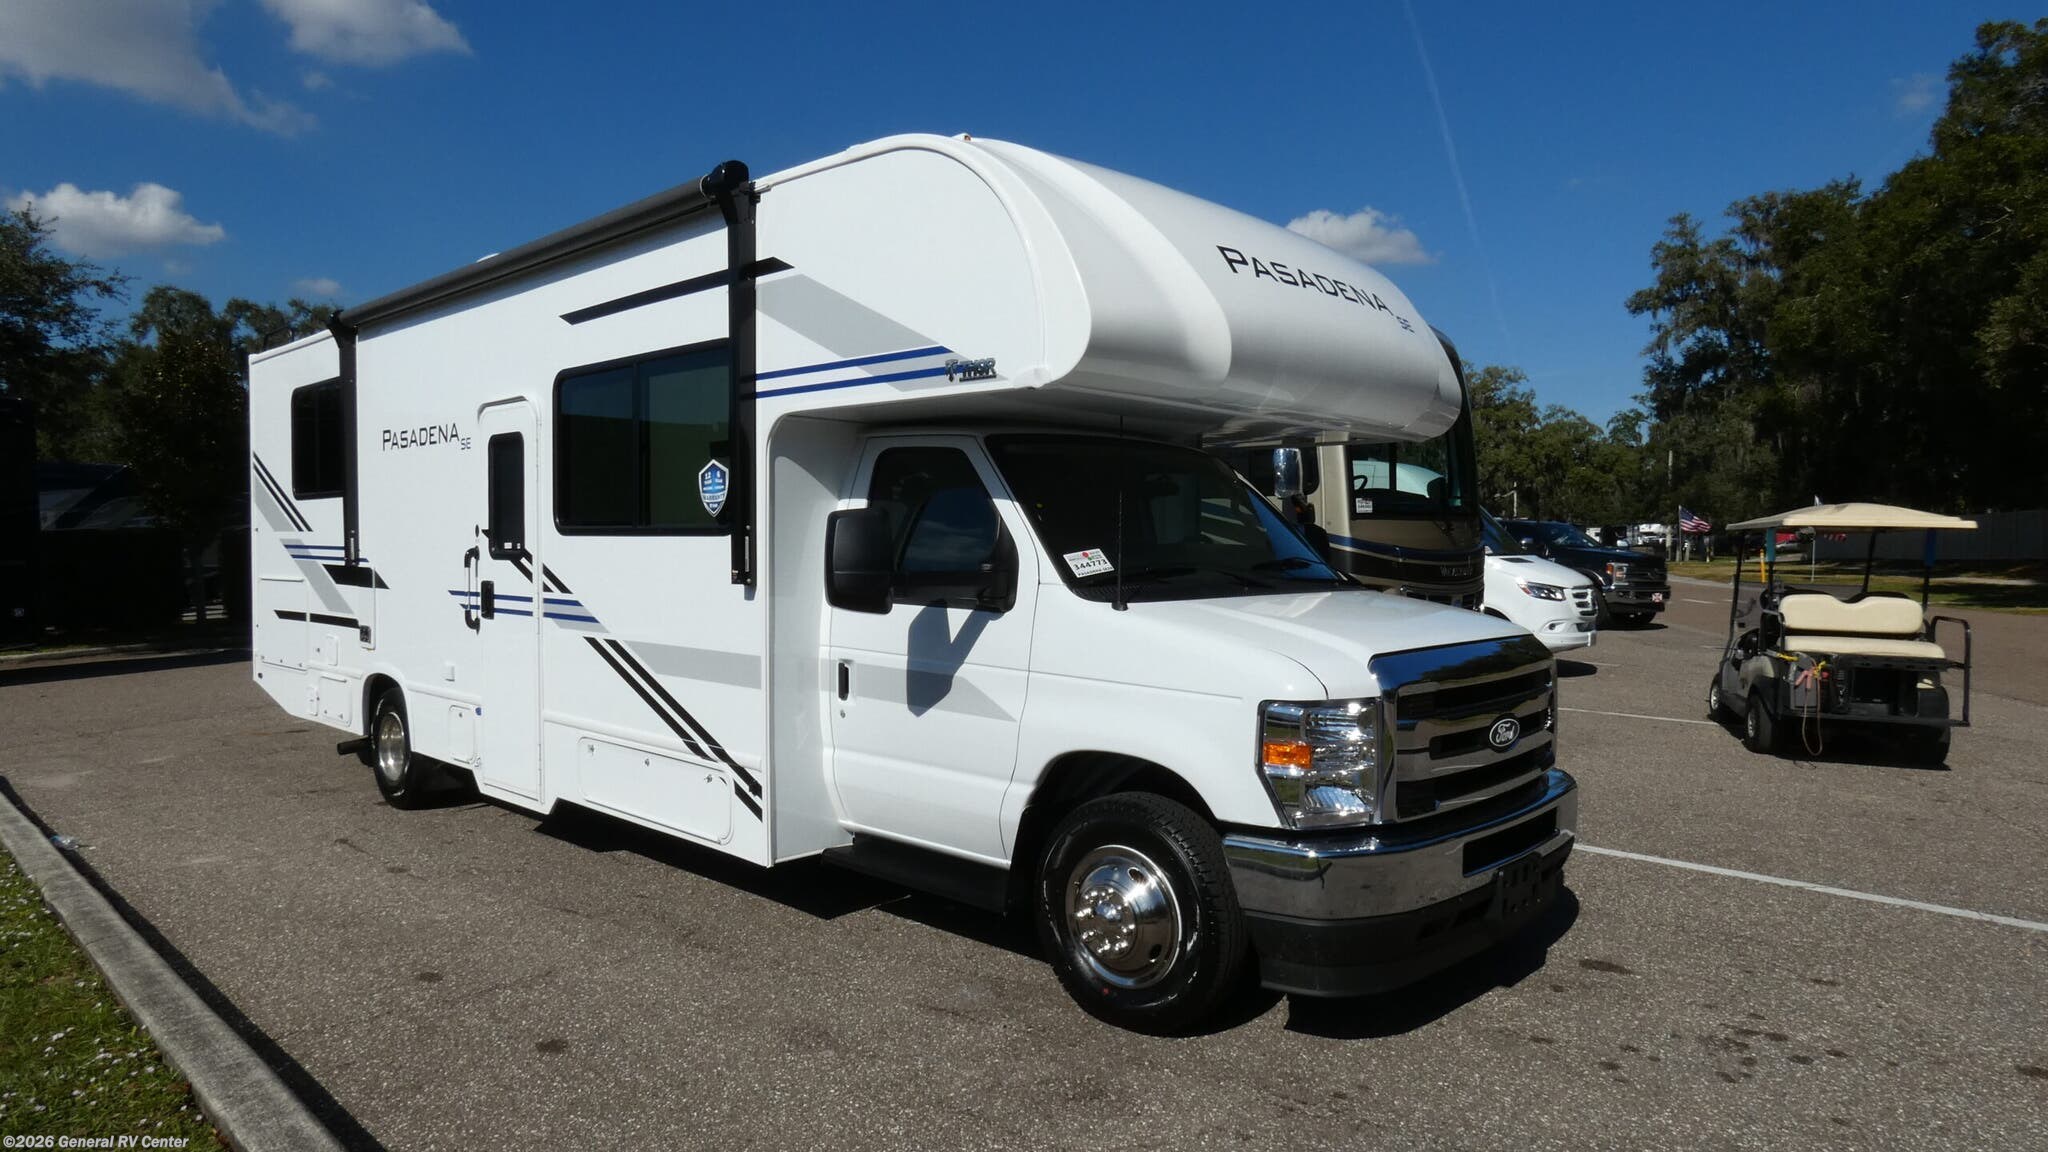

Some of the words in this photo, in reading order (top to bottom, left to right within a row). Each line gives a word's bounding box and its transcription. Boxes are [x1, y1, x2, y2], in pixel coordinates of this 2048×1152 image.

[1216, 245, 1394, 316] PASADENA
[1396, 316, 1415, 334] SE
[382, 422, 460, 451] PASADENA
[461, 437, 471, 450] SE
[1496, 722, 1515, 743] Ford
